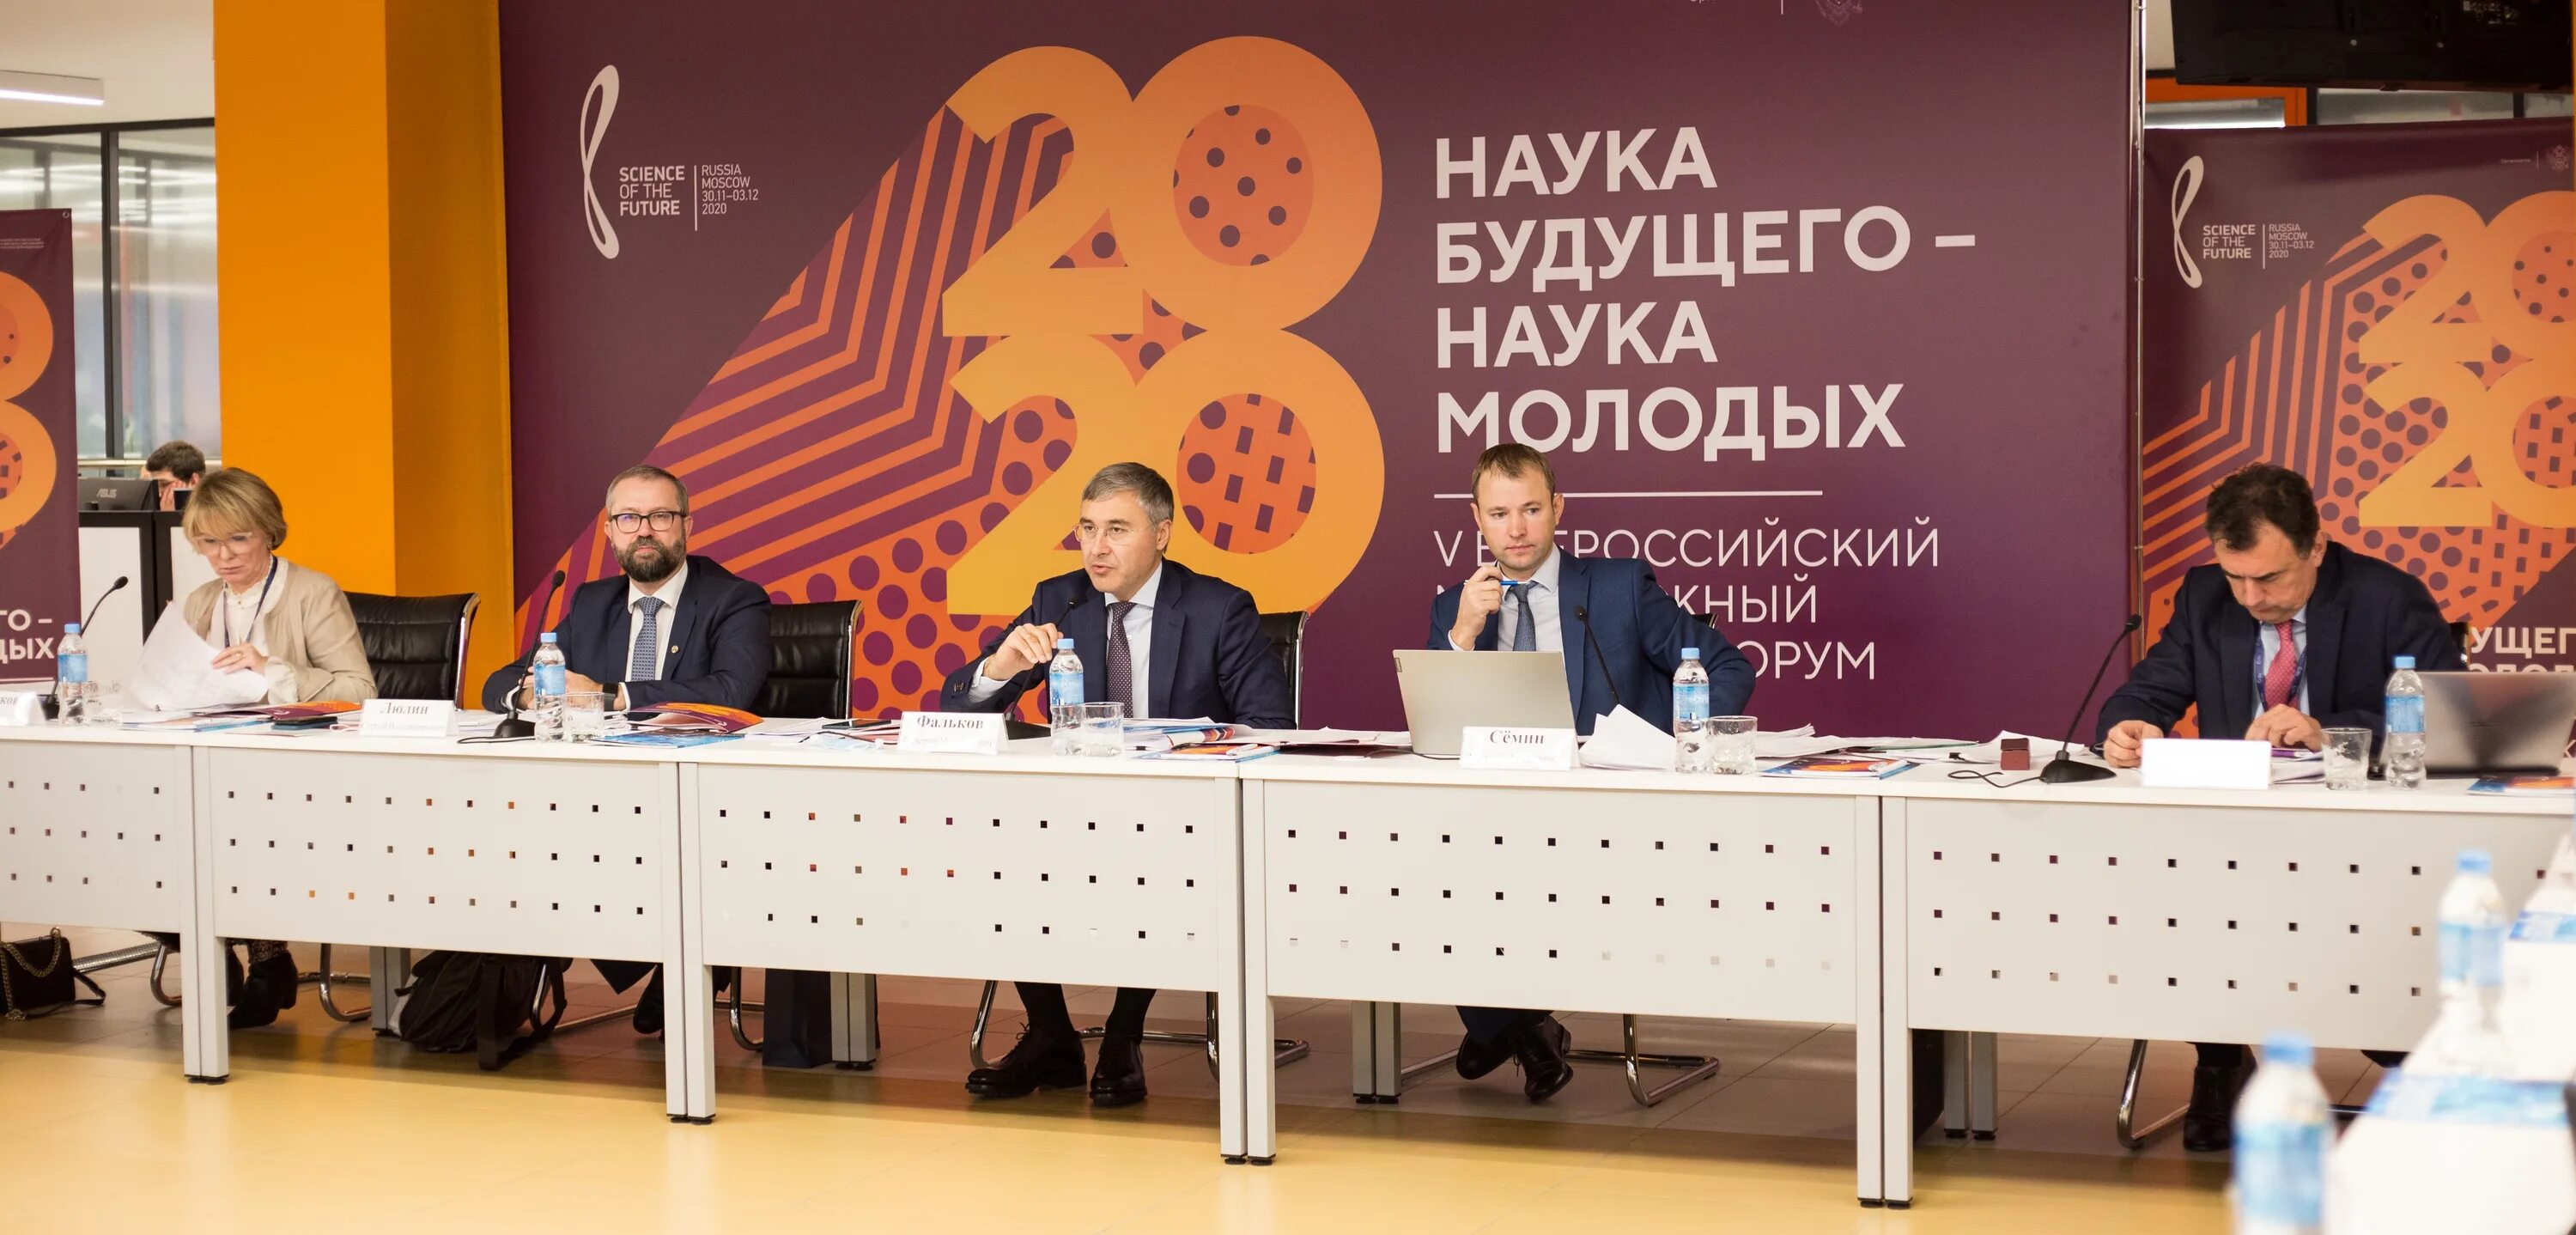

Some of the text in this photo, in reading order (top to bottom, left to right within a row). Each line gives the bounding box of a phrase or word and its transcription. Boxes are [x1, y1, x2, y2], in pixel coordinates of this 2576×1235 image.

[1437, 126, 1717, 199] НАУКА
[619, 166, 685, 182] SCIENCE
[702, 164, 742, 176] RUSSIA
[702, 176, 750, 189] MOSCOW
[619, 183, 672, 199] OF THE
[620, 200, 680, 216] FUTURE
[702, 203, 727, 215] 2020
[2202, 224, 2256, 235] SCIENCE
[2269, 223, 2301, 232] RUSSIA
[2202, 236, 2245, 247] OF THE
[2269, 232, 2308, 240] MOSCOW
[1437, 205, 1911, 293] БУДУЩЕГО
[2202, 248, 2251, 259] FUTURE
[2269, 250, 2289, 259] 2020
[1437, 301, 1718, 368] НАУКА
[1437, 383, 1905, 462] МОЛОДЫХ
[1736, 641, 1874, 680] ОРУМ
[916, 715, 983, 729] Фальков
[1489, 729, 1544, 744] Сёмин
